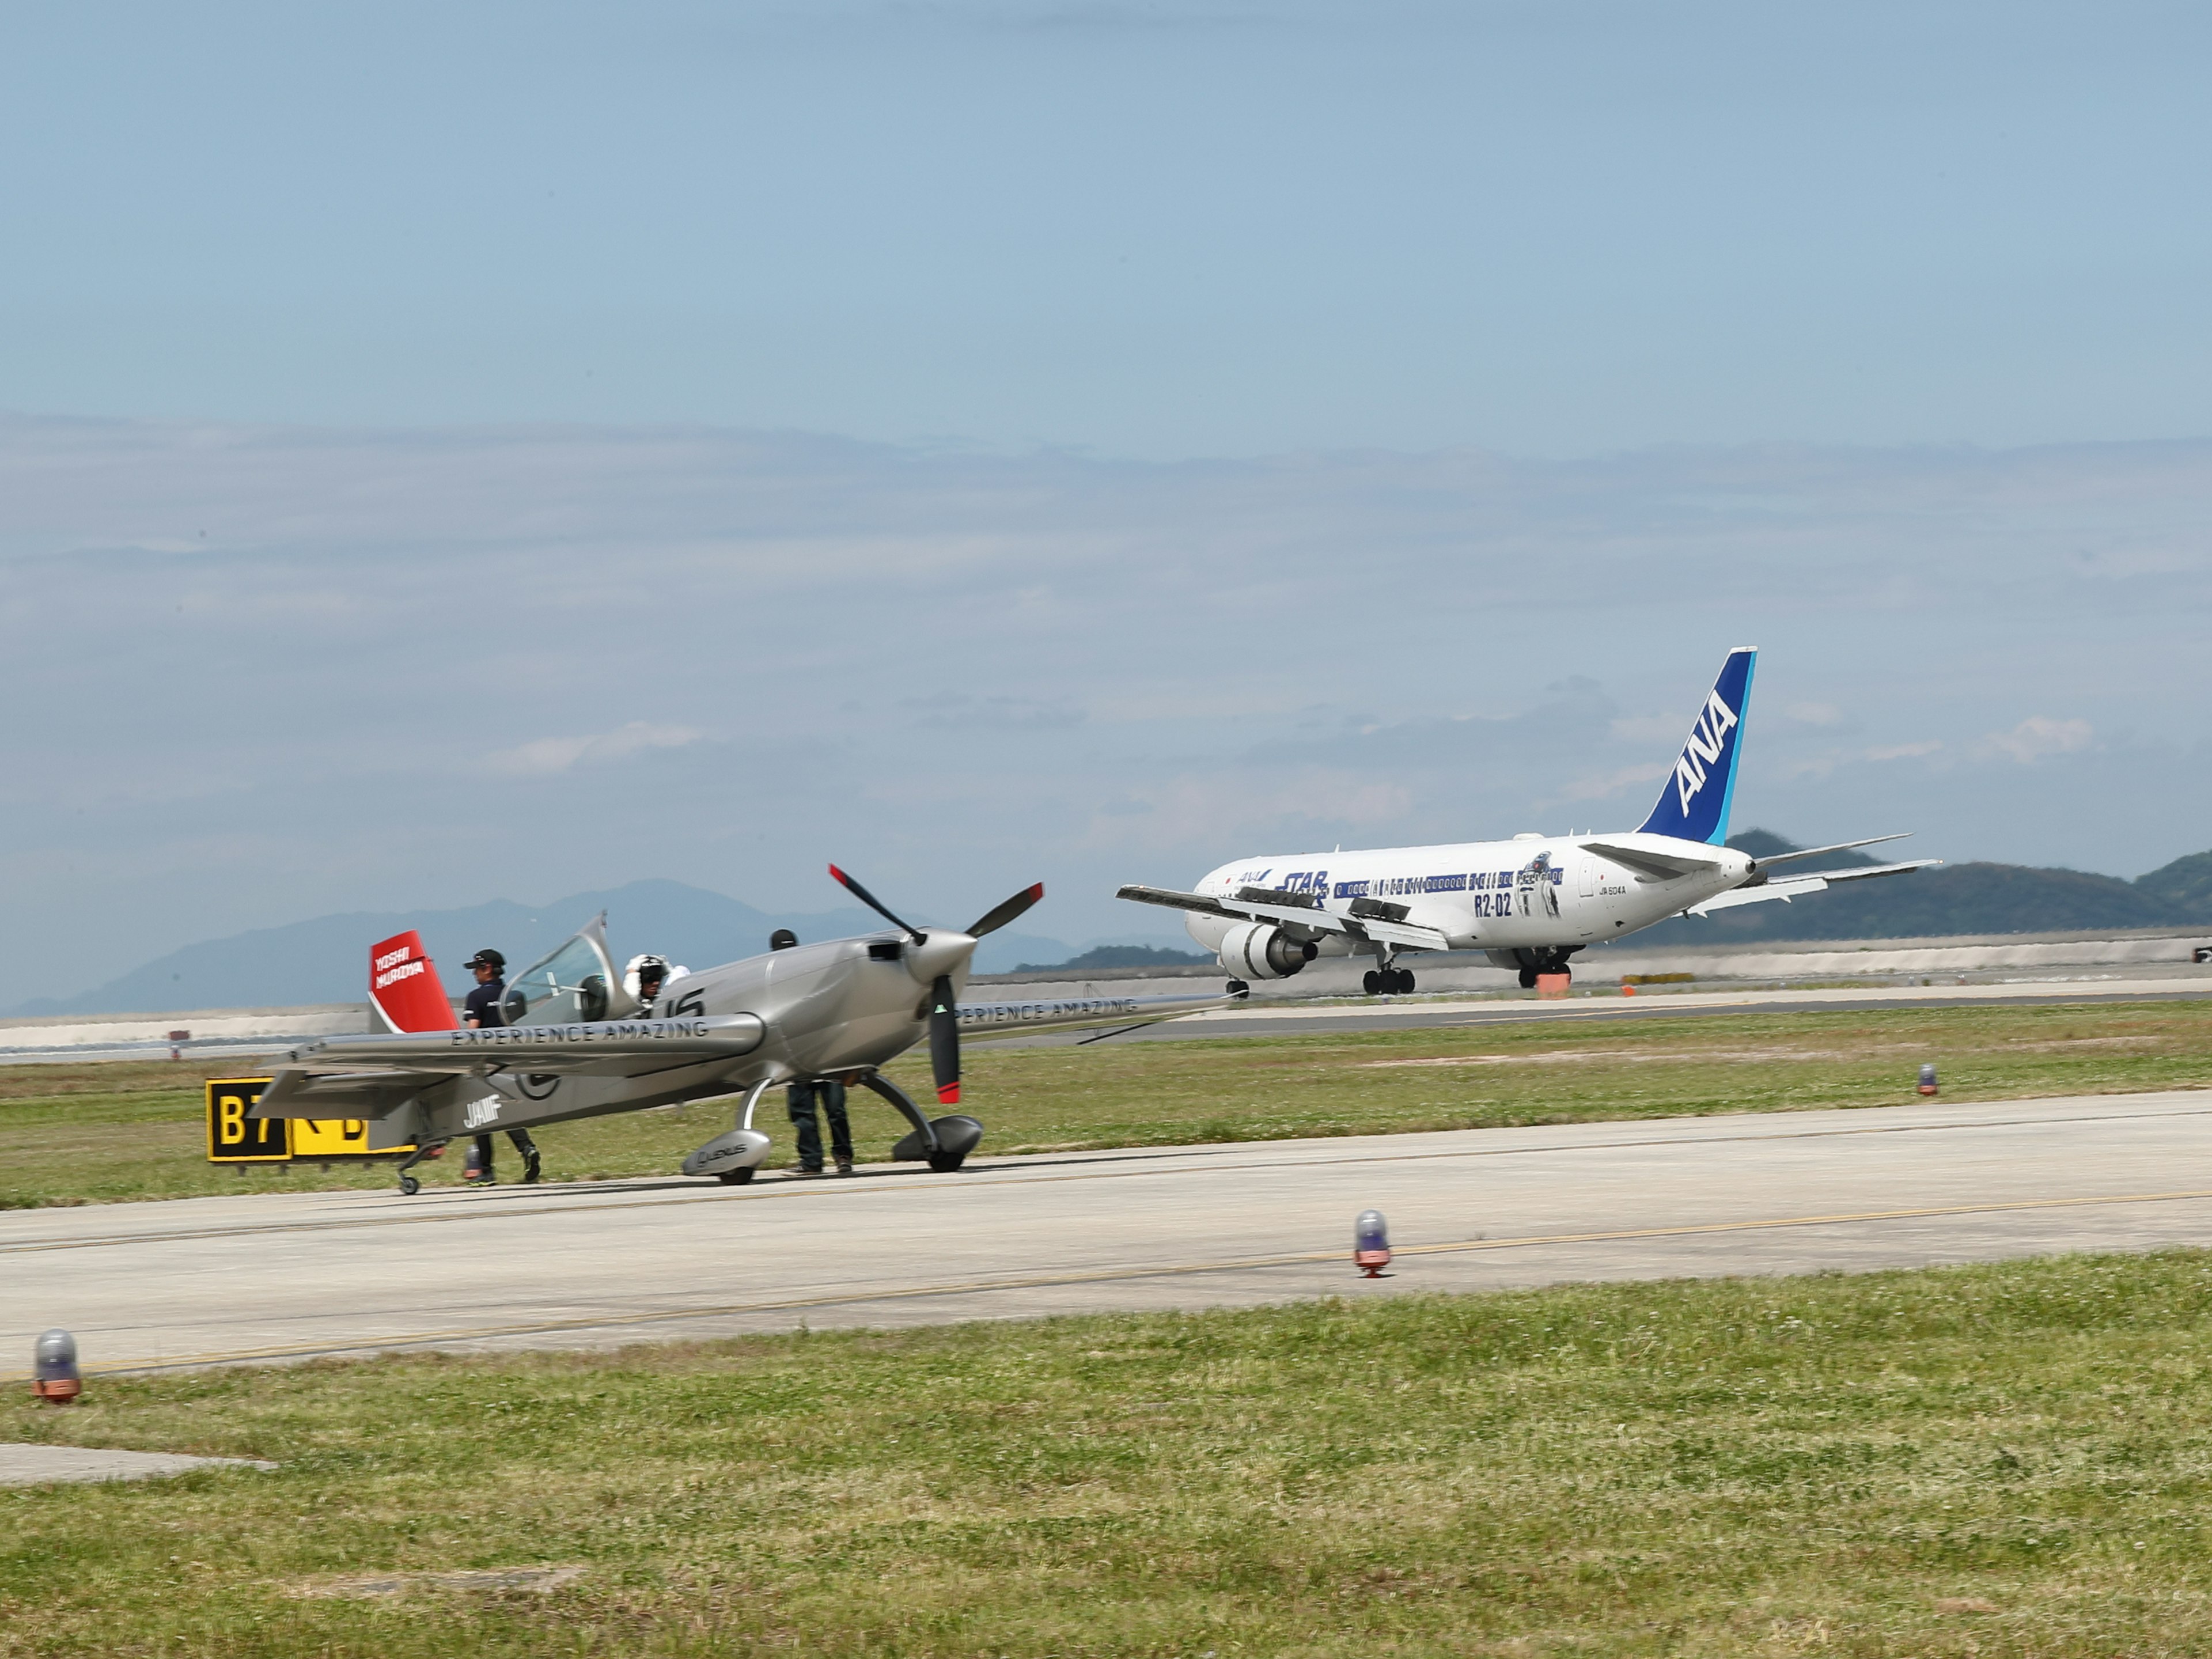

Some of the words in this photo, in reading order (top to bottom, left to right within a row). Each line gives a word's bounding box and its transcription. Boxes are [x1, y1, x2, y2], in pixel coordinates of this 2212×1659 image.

[1676, 689, 1738, 818] ANA
[1275, 871, 1328, 894] STAR
[1475, 892, 1512, 918] R2-D2
[375, 946, 410, 972] YOSHI
[1051, 999, 1138, 1018] AMAZING
[451, 1026, 593, 1046] EXPERIENCE
[603, 1021, 709, 1041] AMAZING
[219, 1095, 271, 1145] B7
